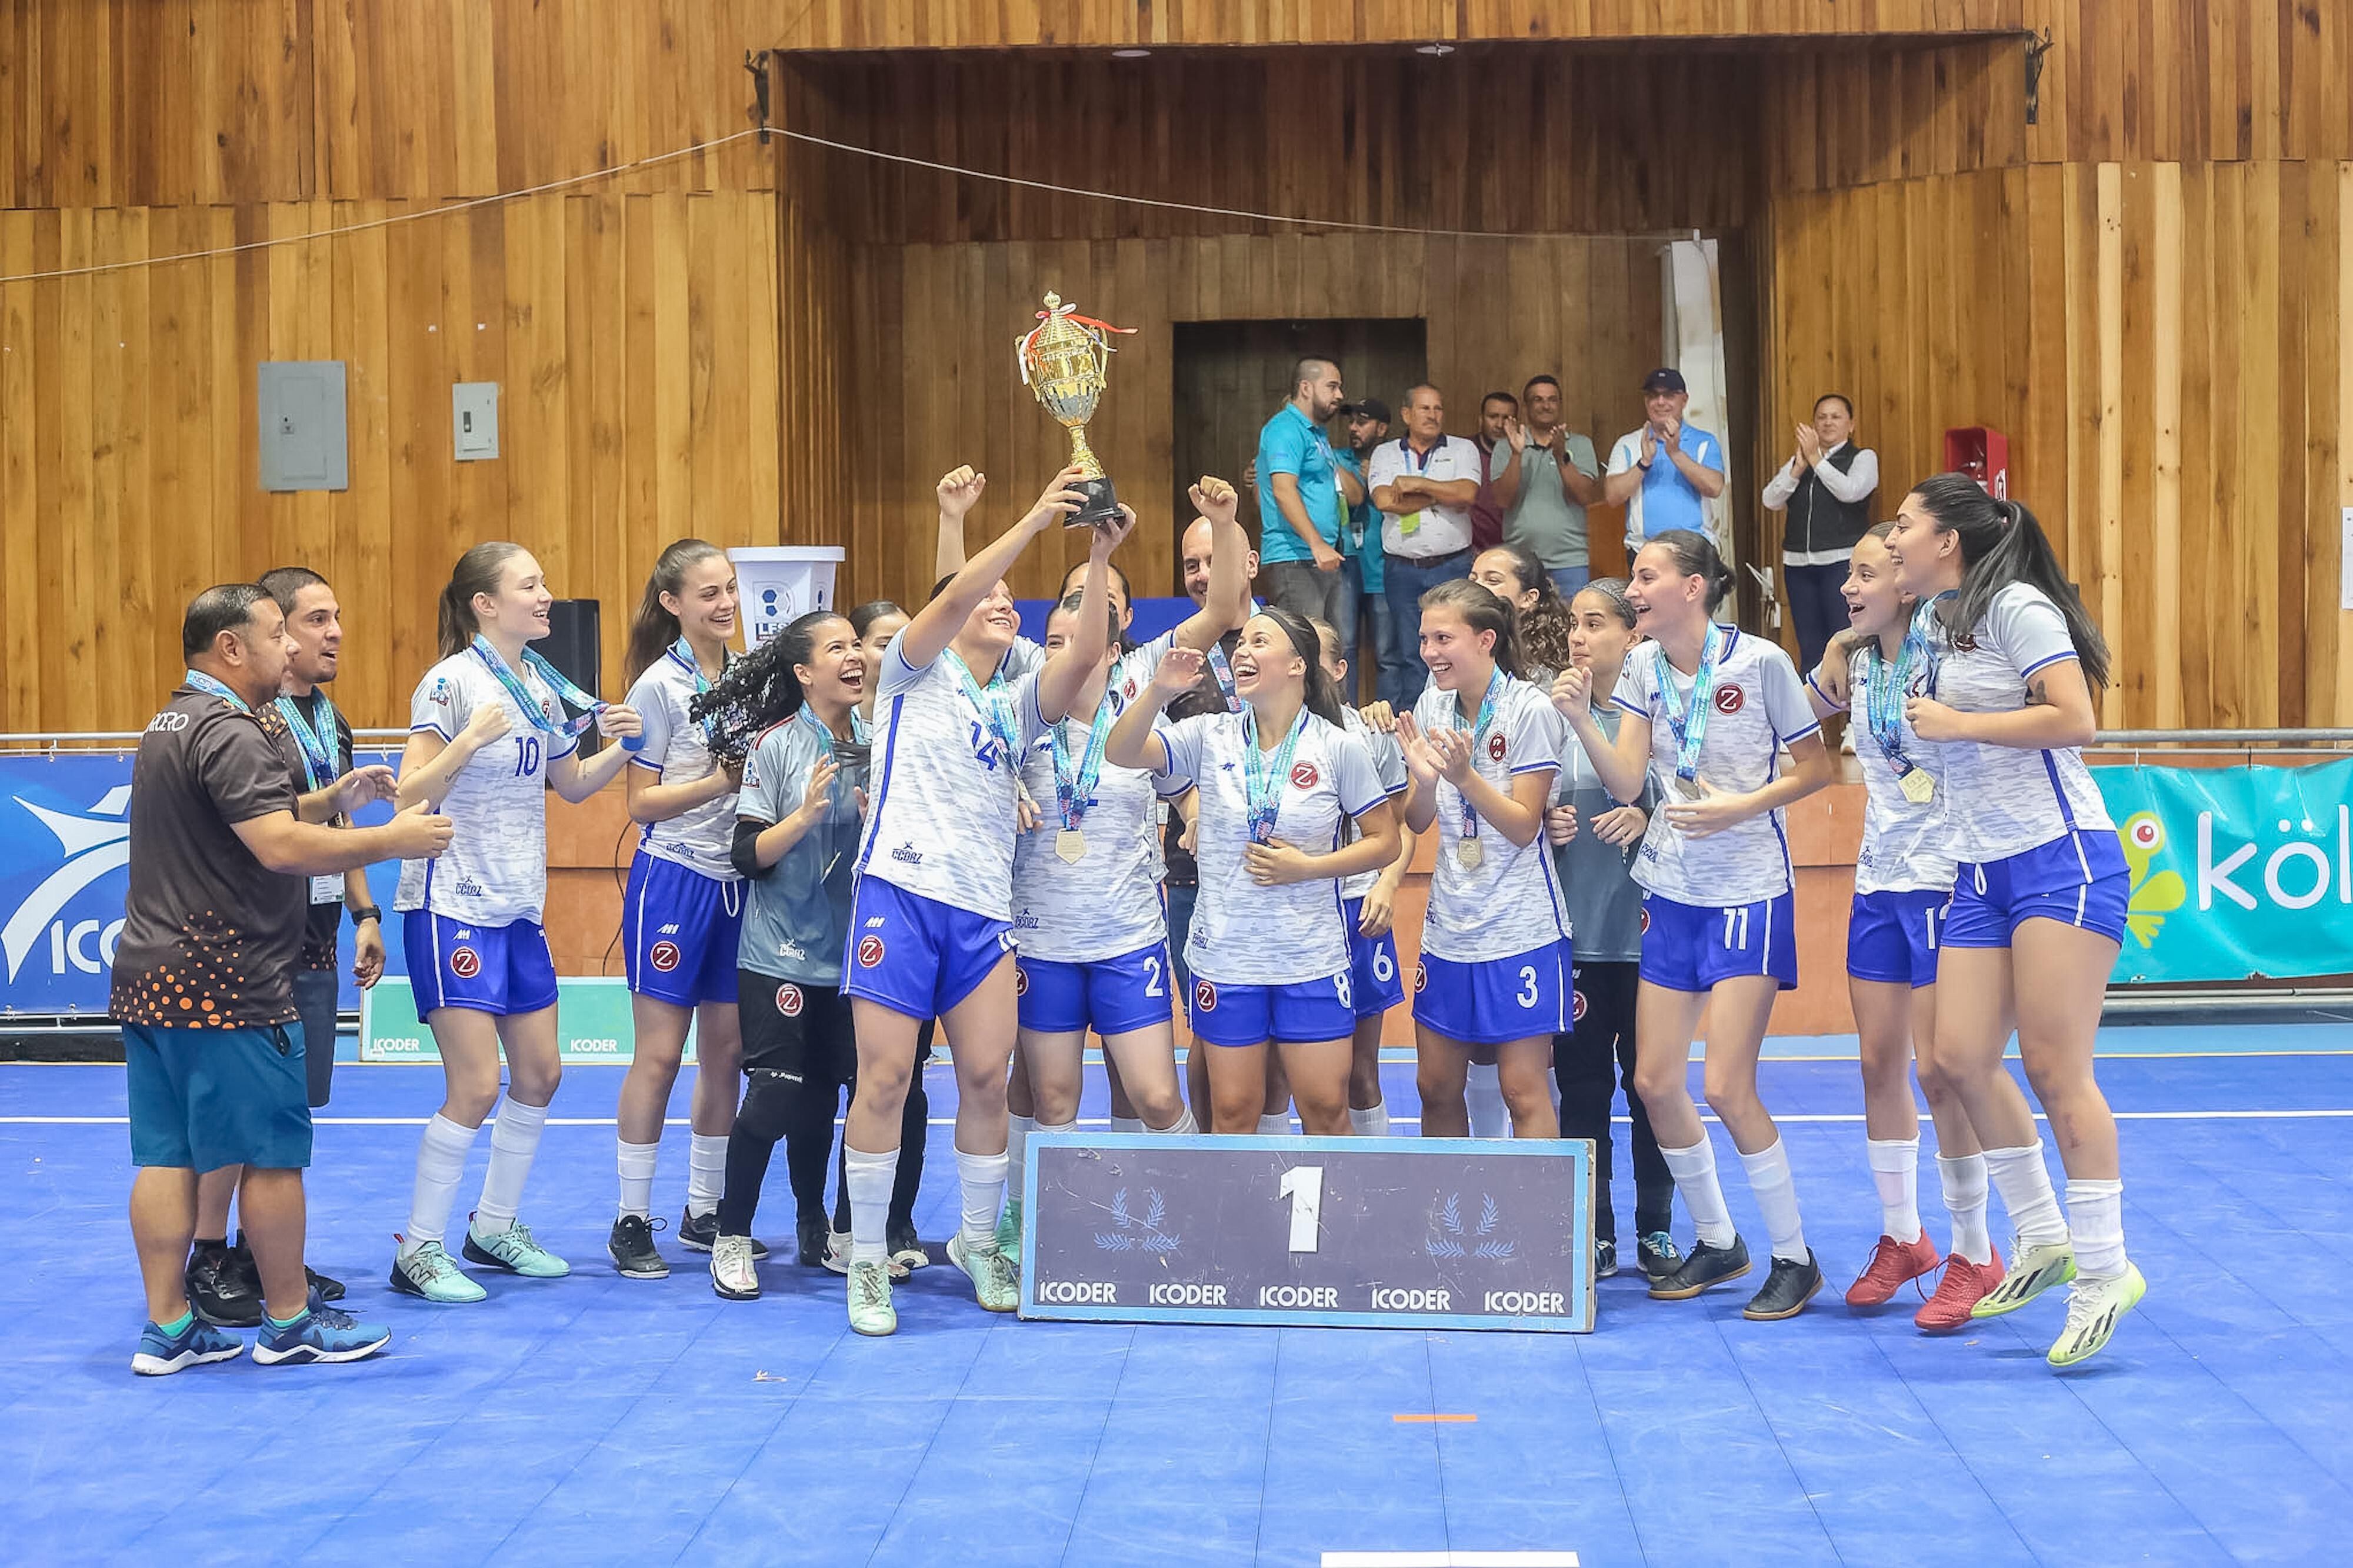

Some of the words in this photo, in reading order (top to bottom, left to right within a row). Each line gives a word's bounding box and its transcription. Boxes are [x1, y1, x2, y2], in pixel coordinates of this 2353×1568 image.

[1721, 689, 1738, 709] Z
[515, 736, 539, 776] 10
[971, 720, 998, 771] 14
[1295, 766, 1313, 785] Z
[2198, 803, 2352, 910] köl
[1723, 908, 1749, 950] 11
[456, 953, 475, 973] Z
[656, 947, 672, 966] Z
[862, 942, 877, 962] Z
[1373, 942, 1394, 982] 6
[1144, 956, 1164, 997] 2
[1517, 965, 1538, 1008] 3
[782, 991, 798, 1010] Z
[1199, 986, 1212, 1006] Z
[1334, 972, 1351, 1008] 8
[374, 1038, 420, 1052] ICODER
[570, 1039, 618, 1052] ICODER
[1279, 1166, 1324, 1252] 1
[1039, 1281, 1117, 1303] ICODER
[1149, 1283, 1227, 1306] ICODER
[1259, 1286, 1339, 1308] ICODER
[1371, 1287, 1452, 1311] ICODER
[1484, 1290, 1565, 1314] ICODER
